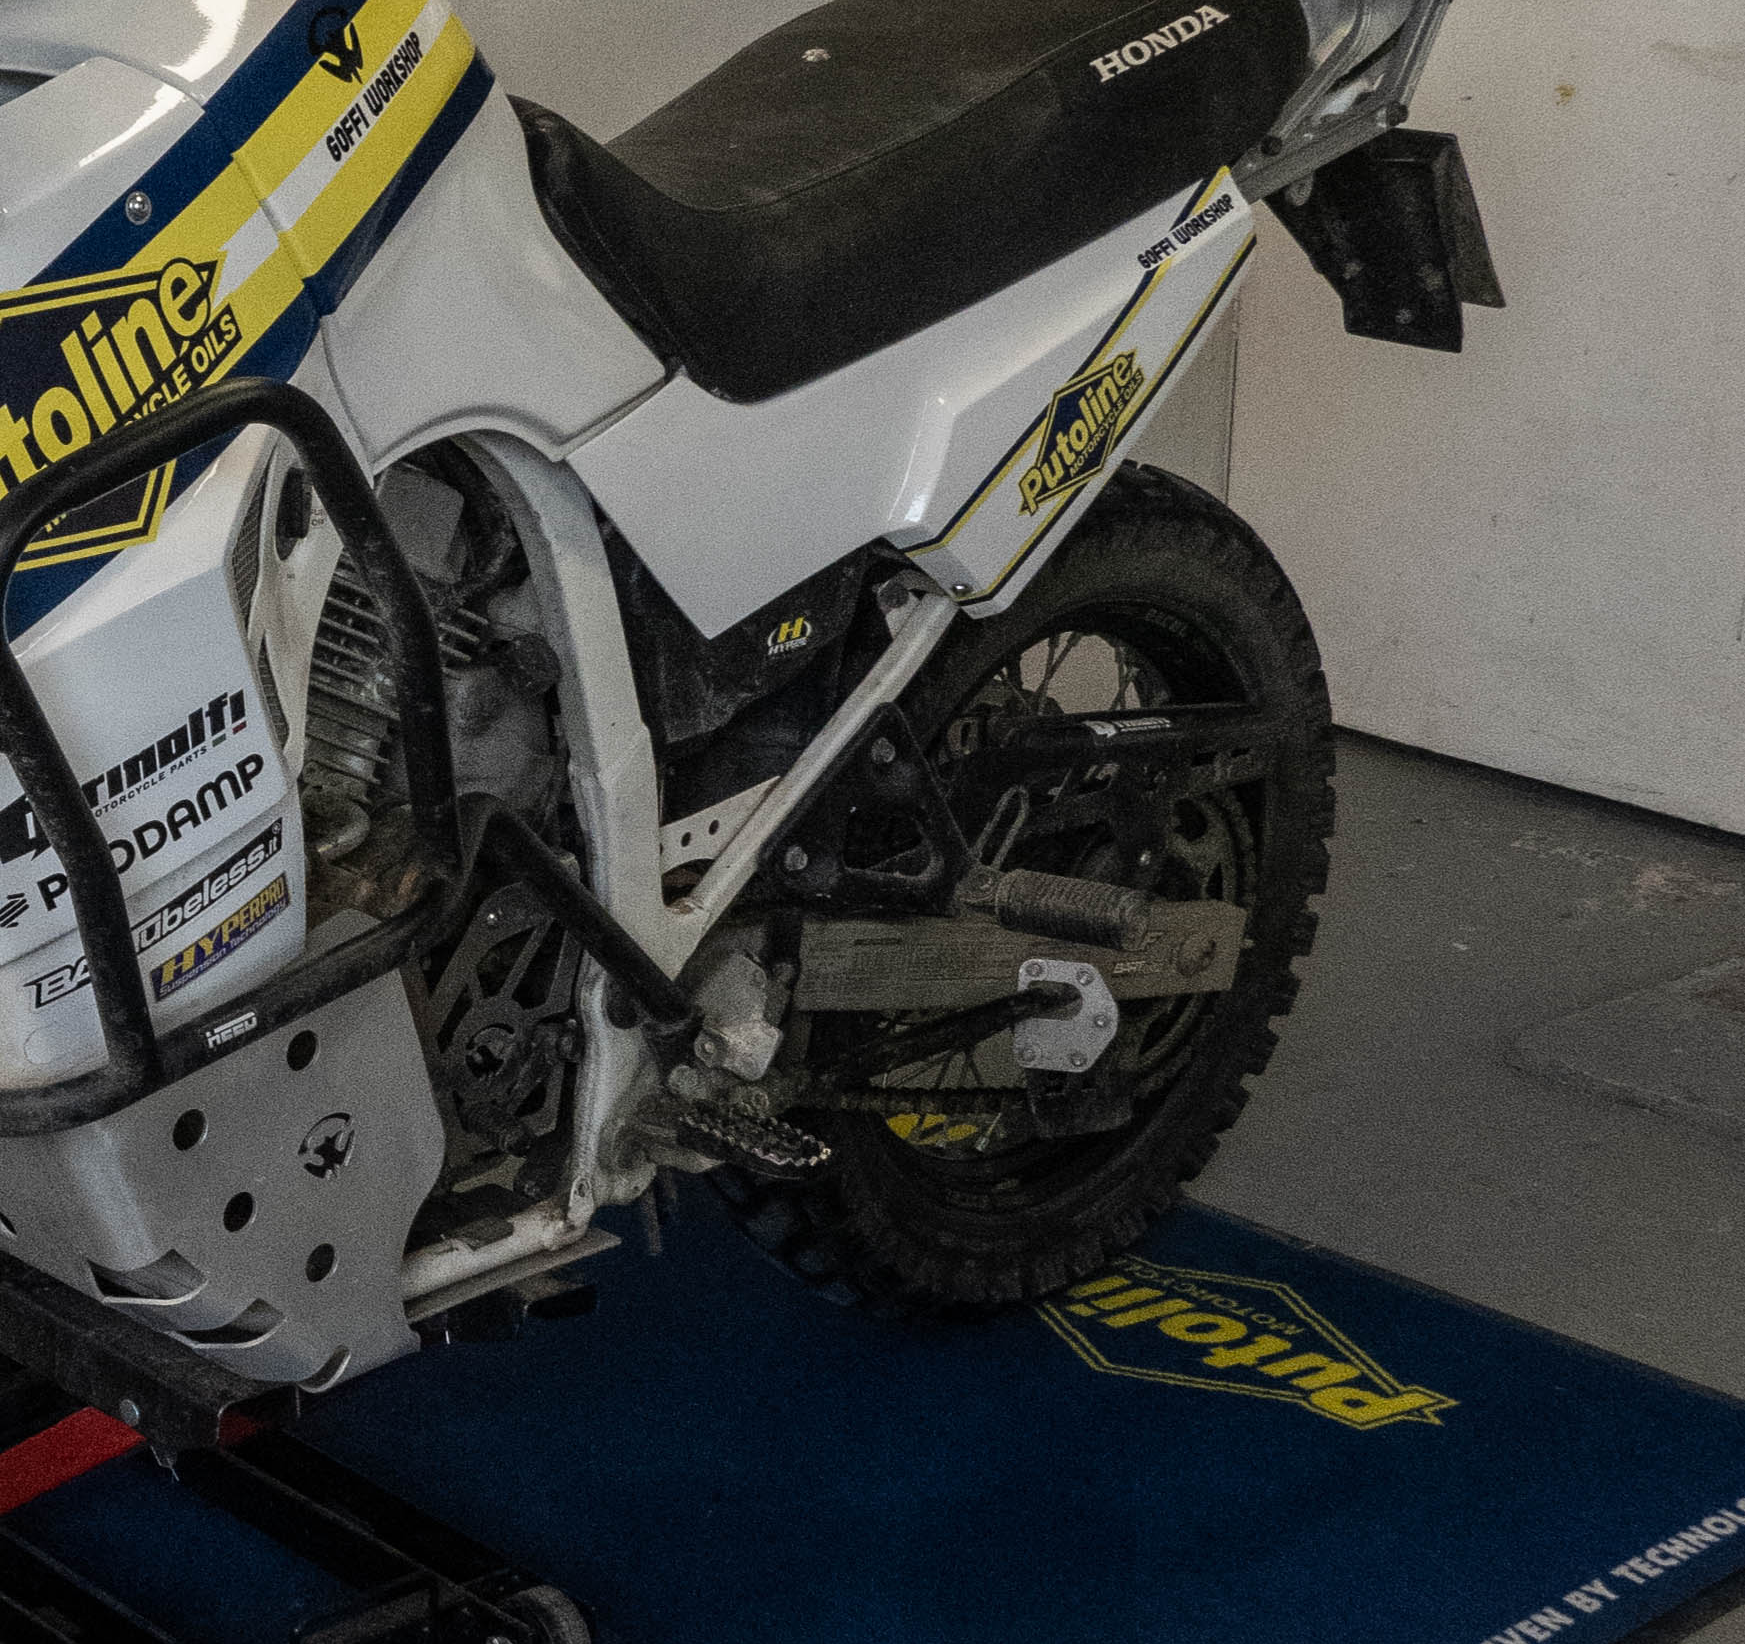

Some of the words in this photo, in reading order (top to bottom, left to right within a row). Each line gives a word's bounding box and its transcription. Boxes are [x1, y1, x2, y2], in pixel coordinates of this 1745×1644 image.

[1089, 4, 1230, 83] HONDA
[325, 102, 370, 162] GOFFI
[362, 31, 423, 117] WORKSHOP
[1136, 236, 1178, 270] GOFFI
[1172, 193, 1235, 247] WORKSHOP
[191, 313, 238, 370] OILS
[1019, 355, 1132, 515] Putoline
[1070, 399, 1124, 477] MOTORCYCLE
[94, 771, 166, 819] OTORCYCLE
[170, 746, 208, 774] PARTS
[37, 753, 265, 912] PODAMP
[161, 875, 286, 985] HYPERPRO
[1064, 1274, 1439, 1422] Putoli
[1561, 1578, 1621, 1615] BY
